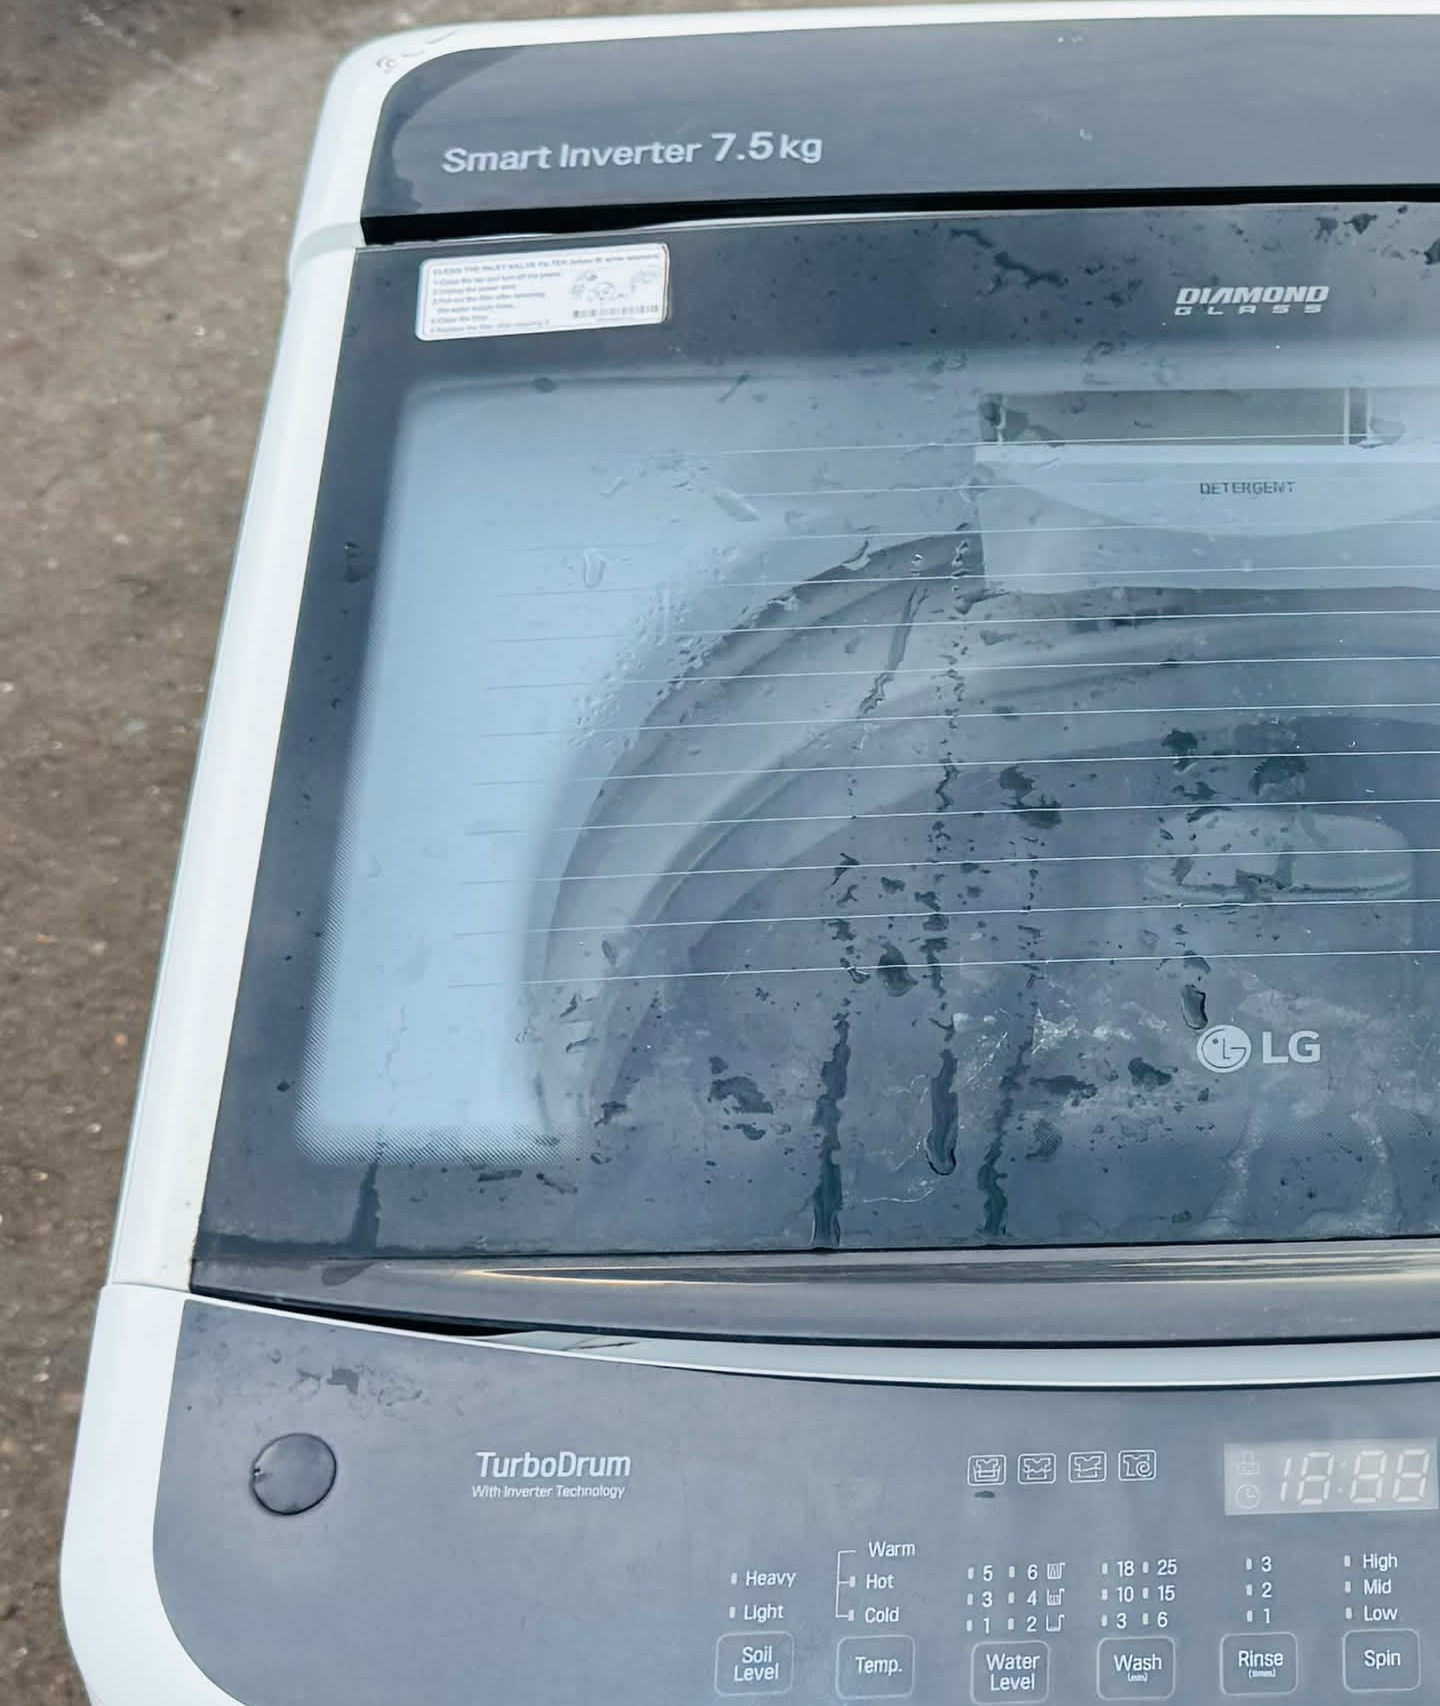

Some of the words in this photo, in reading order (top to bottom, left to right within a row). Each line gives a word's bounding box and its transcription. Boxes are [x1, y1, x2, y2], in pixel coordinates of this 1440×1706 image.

[442, 148, 552, 174] Smart
[559, 143, 703, 168] Inverter
[1175, 285, 1329, 305] DIAMOND
[1174, 304, 1323, 316] GLASS
[1199, 480, 1297, 495] DETERGENT
[1262, 1030, 1321, 1064] LG
[475, 1451, 632, 1479] TurboDrum
[472, 1485, 501, 1498] With
[504, 1485, 553, 1498] Inverter
[555, 1484, 626, 1500] Technology
[868, 1541, 916, 1558] Warm
[1116, 1560, 1135, 1578] 18
[1157, 1559, 1178, 1576] 25
[1261, 1556, 1272, 1573] 3
[1362, 1553, 1398, 1572] High
[745, 1570, 797, 1589] Heavy
[866, 1574, 895, 1590] Hot
[983, 1565, 994, 1582] 5
[1027, 1564, 1039, 1581] 6
[1116, 1586, 1135, 1603] 10
[1157, 1585, 1176, 1602] 15
[1261, 1581, 1273, 1598] 2
[1363, 1578, 1392, 1595] Mid
[982, 1591, 993, 1608] 3
[1026, 1590, 1038, 1606] 4
[743, 1603, 785, 1623] Light
[864, 1606, 900, 1624] Cold
[1116, 1613, 1127, 1630] 3
[1157, 1611, 1168, 1628] 6
[1263, 1607, 1271, 1624] 1
[1363, 1605, 1398, 1621] Low
[983, 1617, 990, 1634] 1
[1026, 1616, 1038, 1633] 2
[742, 1645, 773, 1664] Soil
[986, 1652, 1041, 1671] Water
[1113, 1653, 1162, 1671] Wash
[1238, 1650, 1284, 1667] Rinse
[1364, 1649, 1401, 1670] Spin
[734, 1663, 779, 1682] Level
[855, 1656, 903, 1677] Temp.
[990, 1673, 1036, 1691] Level
